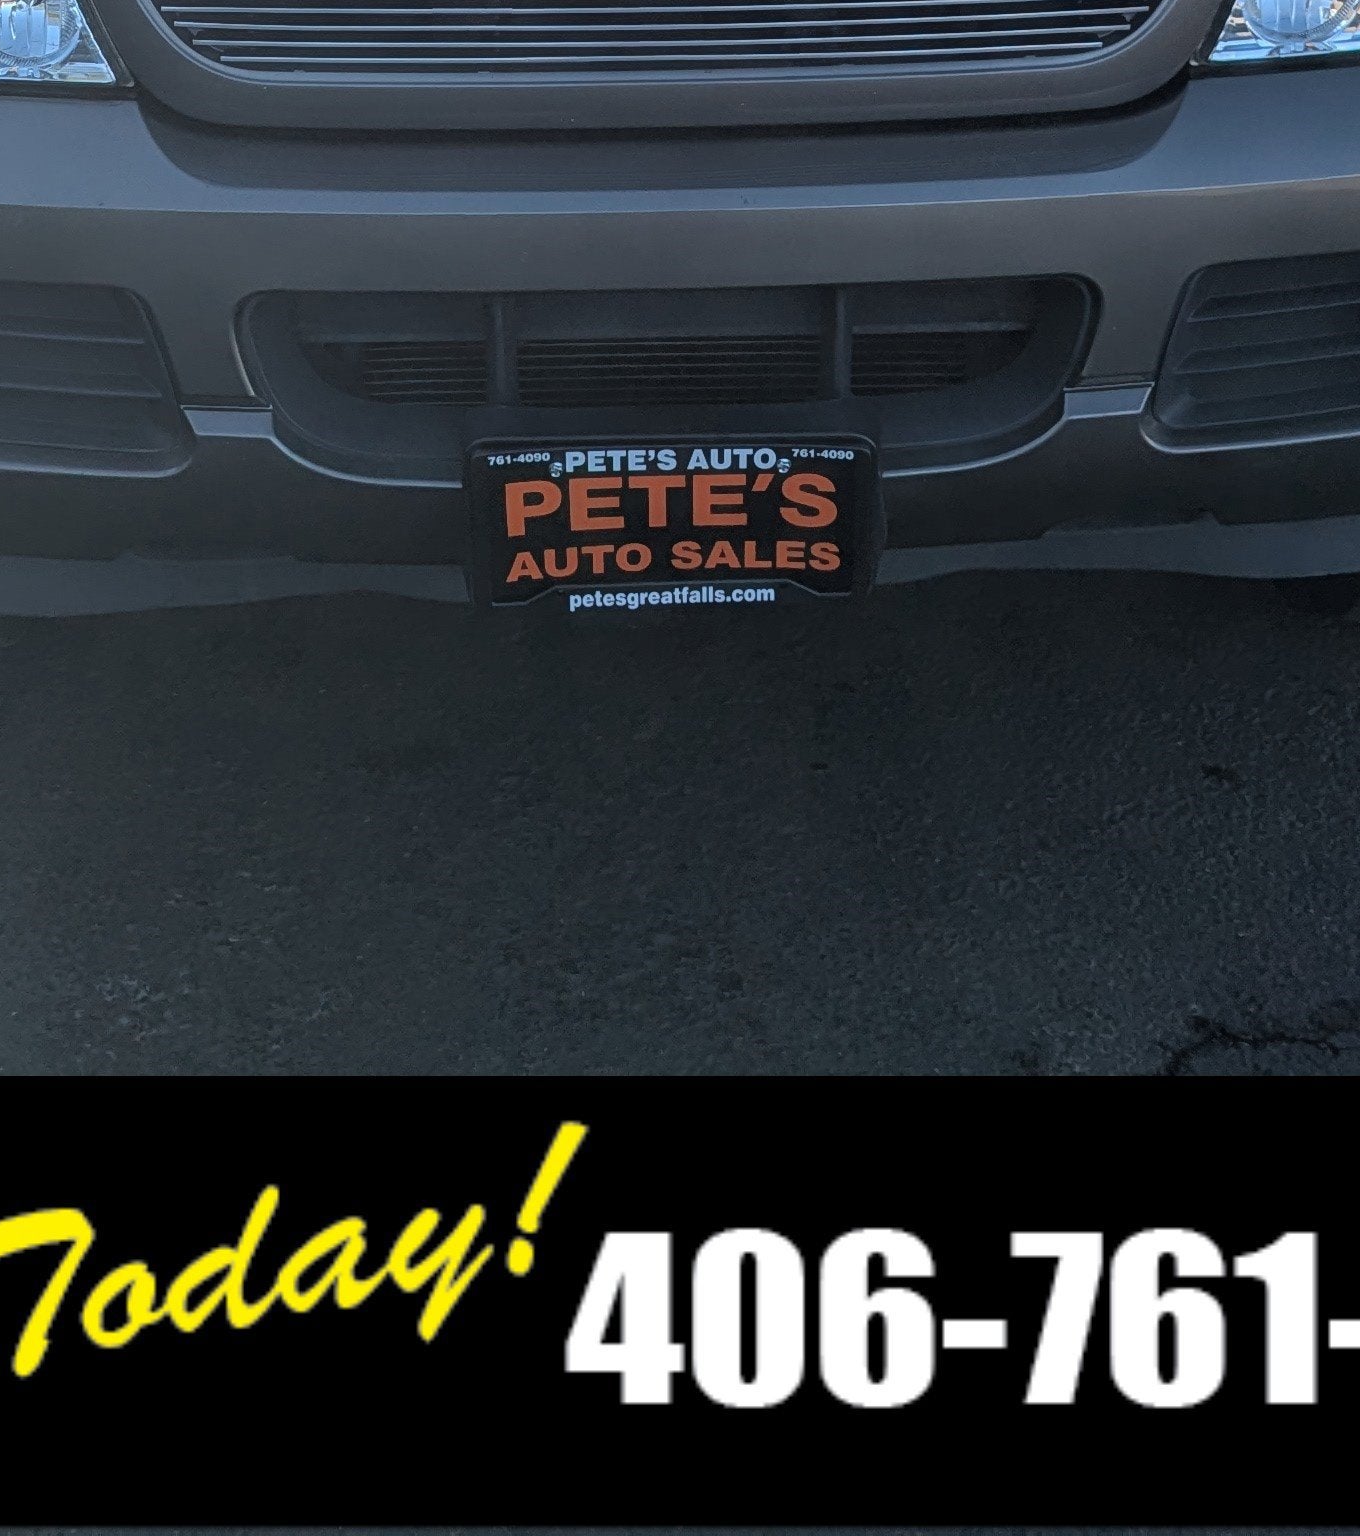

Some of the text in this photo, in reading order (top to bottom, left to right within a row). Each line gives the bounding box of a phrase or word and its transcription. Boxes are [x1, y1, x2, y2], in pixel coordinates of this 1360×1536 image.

[487, 452, 551, 466] 761-4090
[565, 447, 778, 473] PETE'S AUTO
[791, 448, 855, 461] 761-4090
[504, 472, 839, 538] PETE'S
[505, 540, 842, 583] AUTO SALES
[569, 585, 776, 613] petesgreatfalls.com
